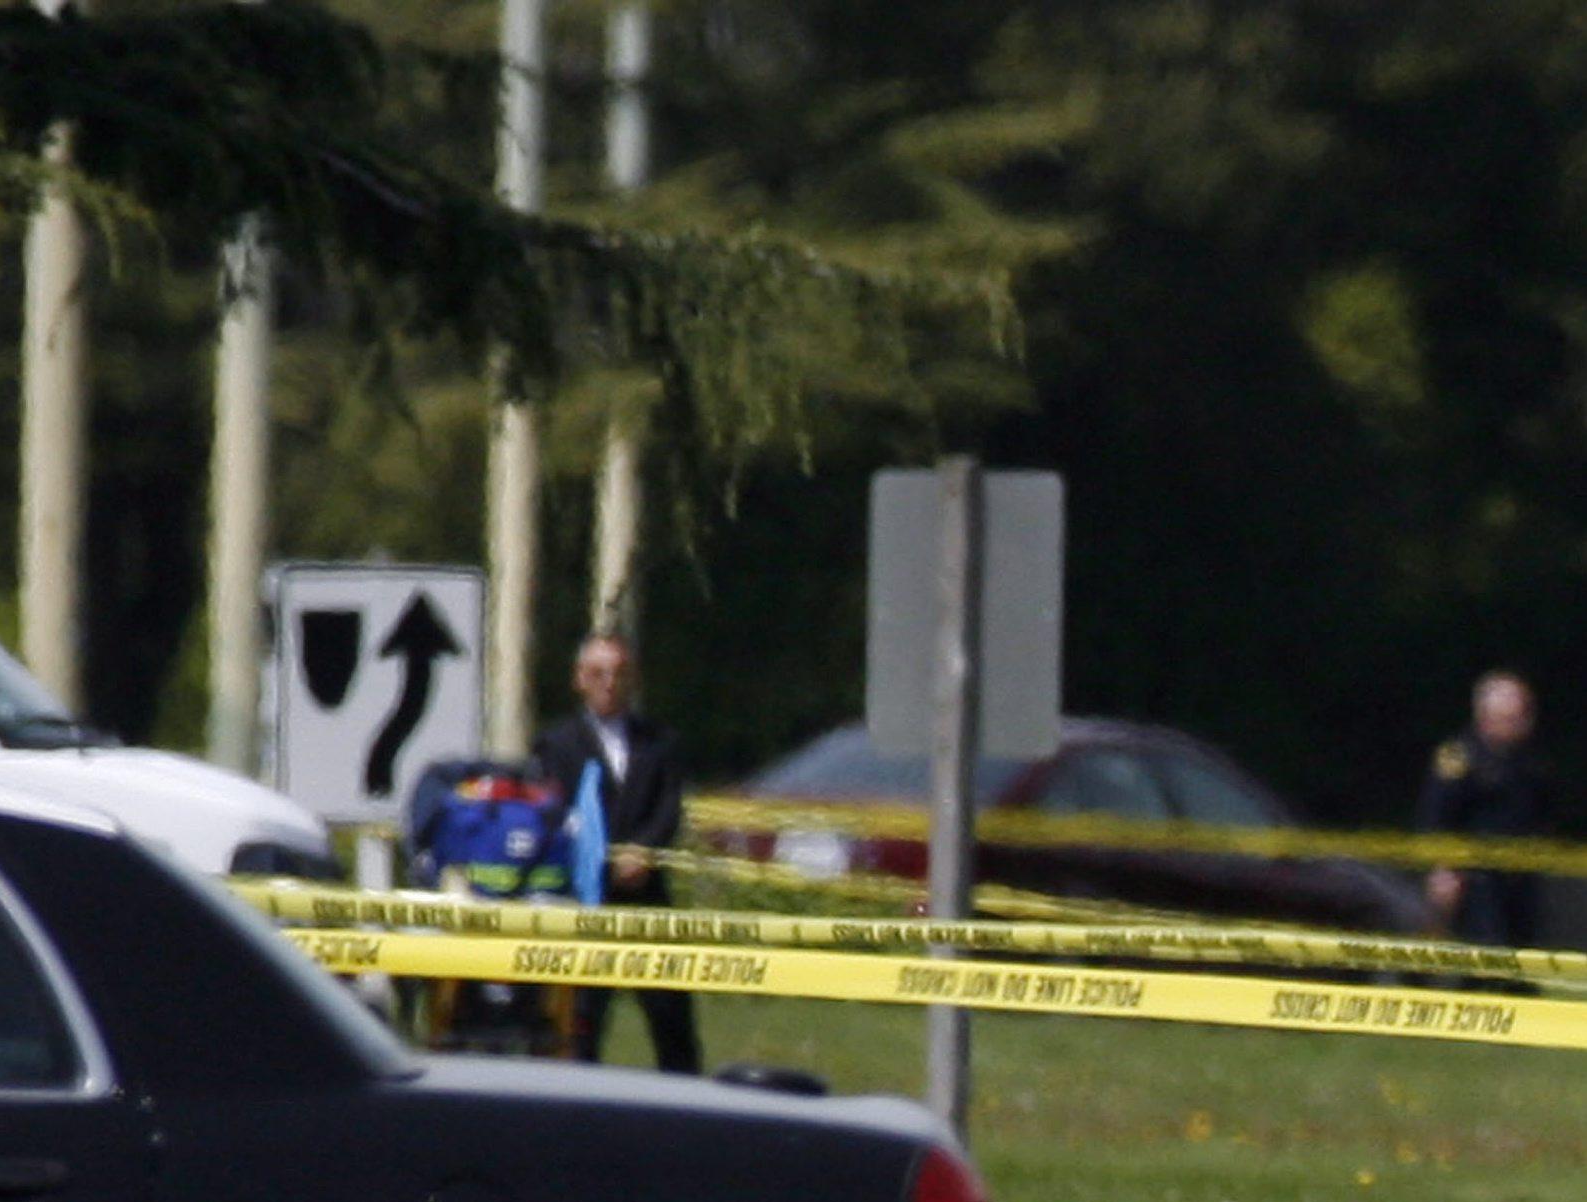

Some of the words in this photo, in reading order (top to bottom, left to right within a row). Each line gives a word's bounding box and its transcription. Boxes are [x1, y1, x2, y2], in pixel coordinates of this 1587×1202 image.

[512, 945, 579, 975] CROSS
[580, 948, 618, 977] NOT
[620, 950, 649, 979] DO
[650, 953, 697, 981] LINE
[699, 955, 768, 985] POLICE
[896, 965, 960, 996] CROSS
[960, 970, 1001, 998] NOT
[1002, 972, 1030, 1000] DO
[1031, 974, 1077, 1003] LINE
[1078, 976, 1146, 1007] POLICE
[1270, 990, 1331, 1021] CROSS
[1331, 995, 1372, 1023] NOT
[1372, 998, 1401, 1026] DO
[1403, 1000, 1448, 1030] LINE
[1448, 1002, 1516, 1034] POLICE
